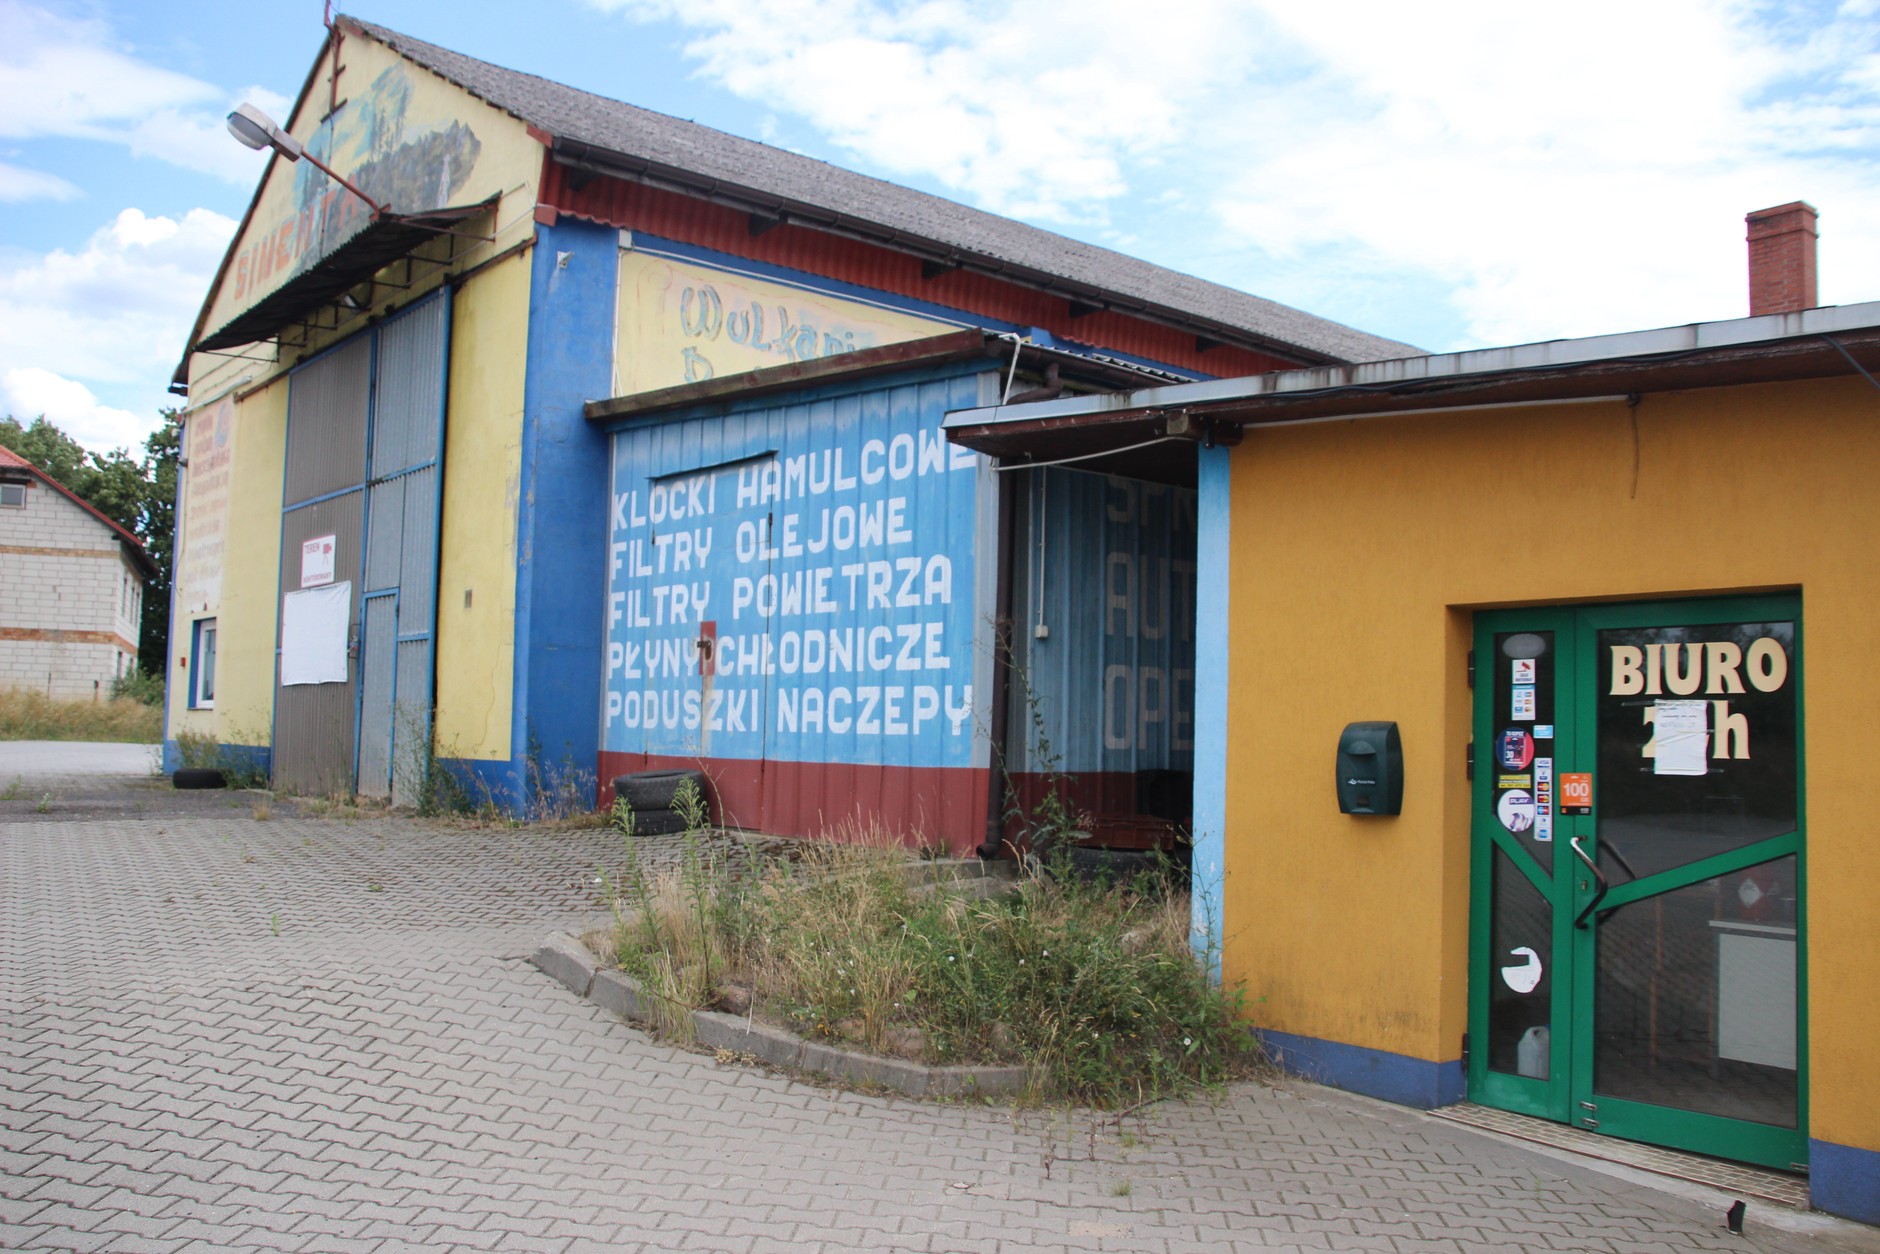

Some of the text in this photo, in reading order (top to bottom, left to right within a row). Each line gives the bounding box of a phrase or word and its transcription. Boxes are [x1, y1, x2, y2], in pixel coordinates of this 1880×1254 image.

[613, 427, 977, 532] KLOCKI HAMULCOWE
[611, 496, 913, 581] FILTRY OLEJOWE
[610, 554, 952, 630] FILTRY POWIETRZA
[608, 622, 951, 680] PŁYNY CHŁODNICZE
[1609, 637, 1788, 696] BIURO
[606, 685, 973, 736] PODUSZKI NACZEPY
[1642, 700, 1751, 760] 2h
[1563, 782, 1590, 797] 100
